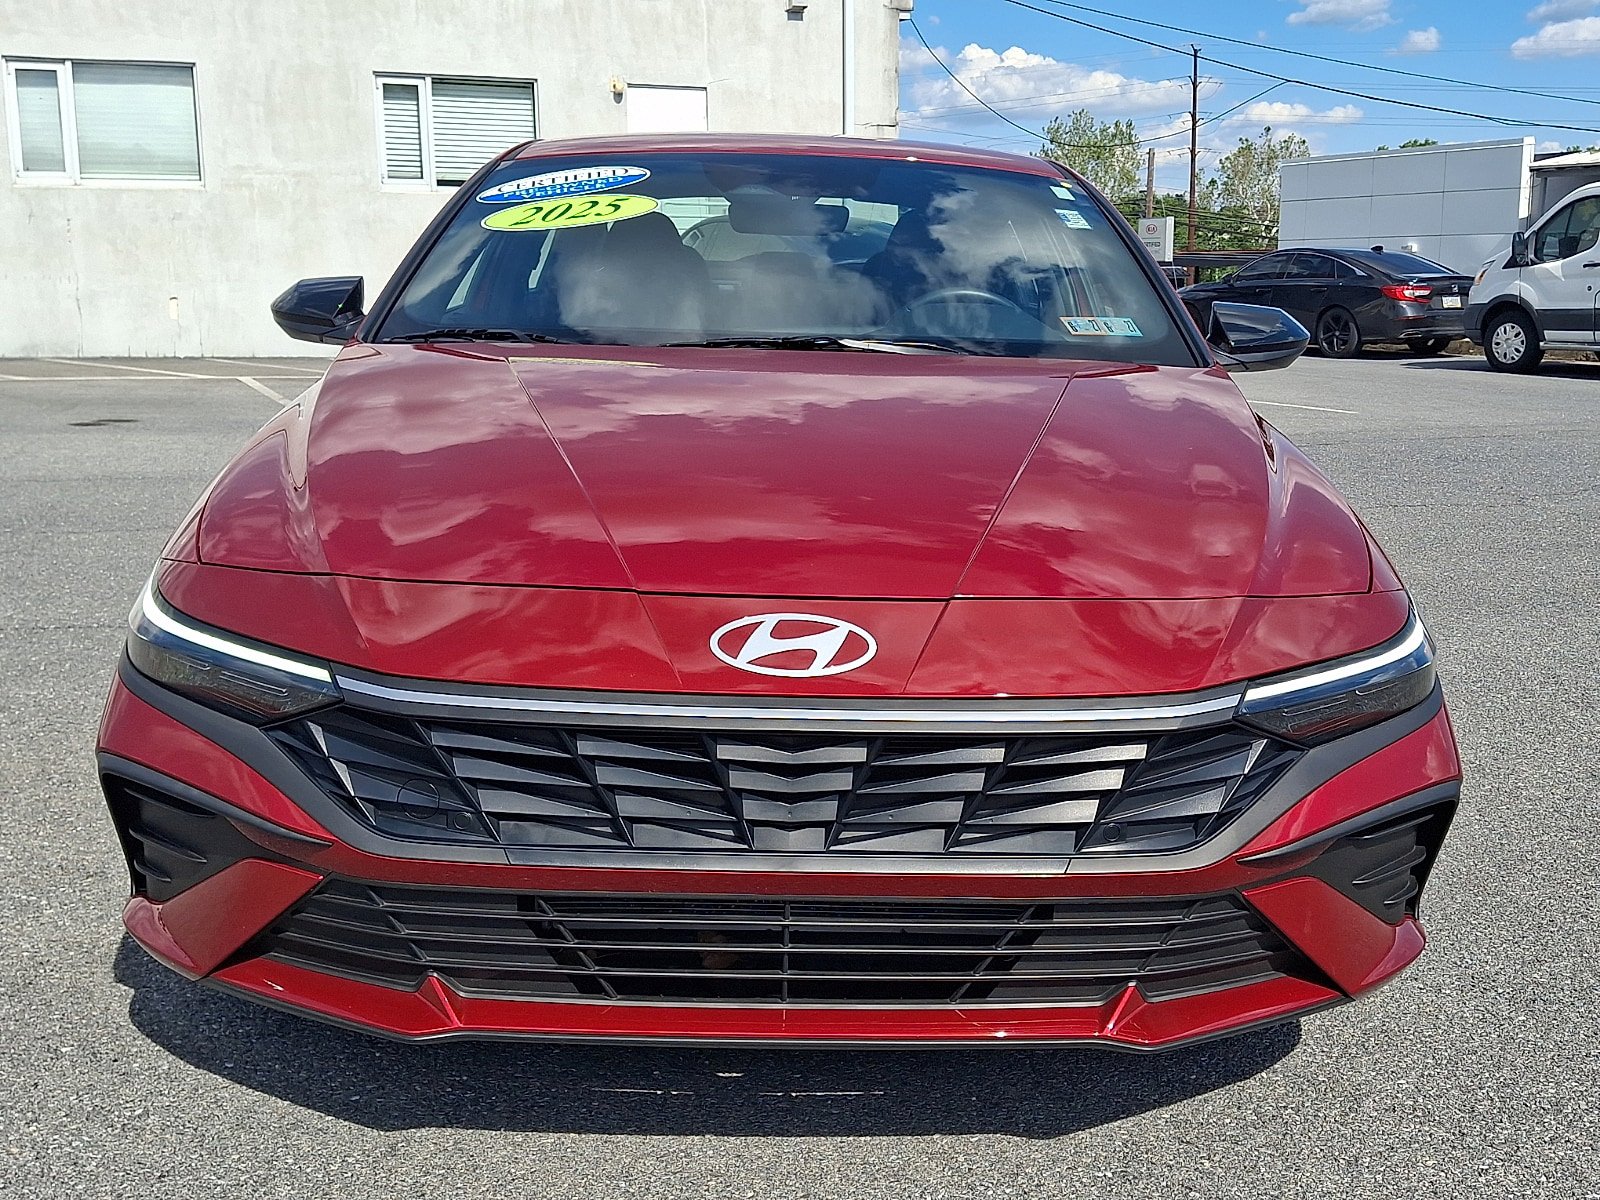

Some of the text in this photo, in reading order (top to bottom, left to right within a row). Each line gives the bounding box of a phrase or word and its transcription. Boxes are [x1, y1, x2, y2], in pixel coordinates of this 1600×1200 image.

[497, 168, 629, 192] CERTIFIED
[520, 183, 606, 199] VEHICLE
[508, 198, 630, 226] 2025
